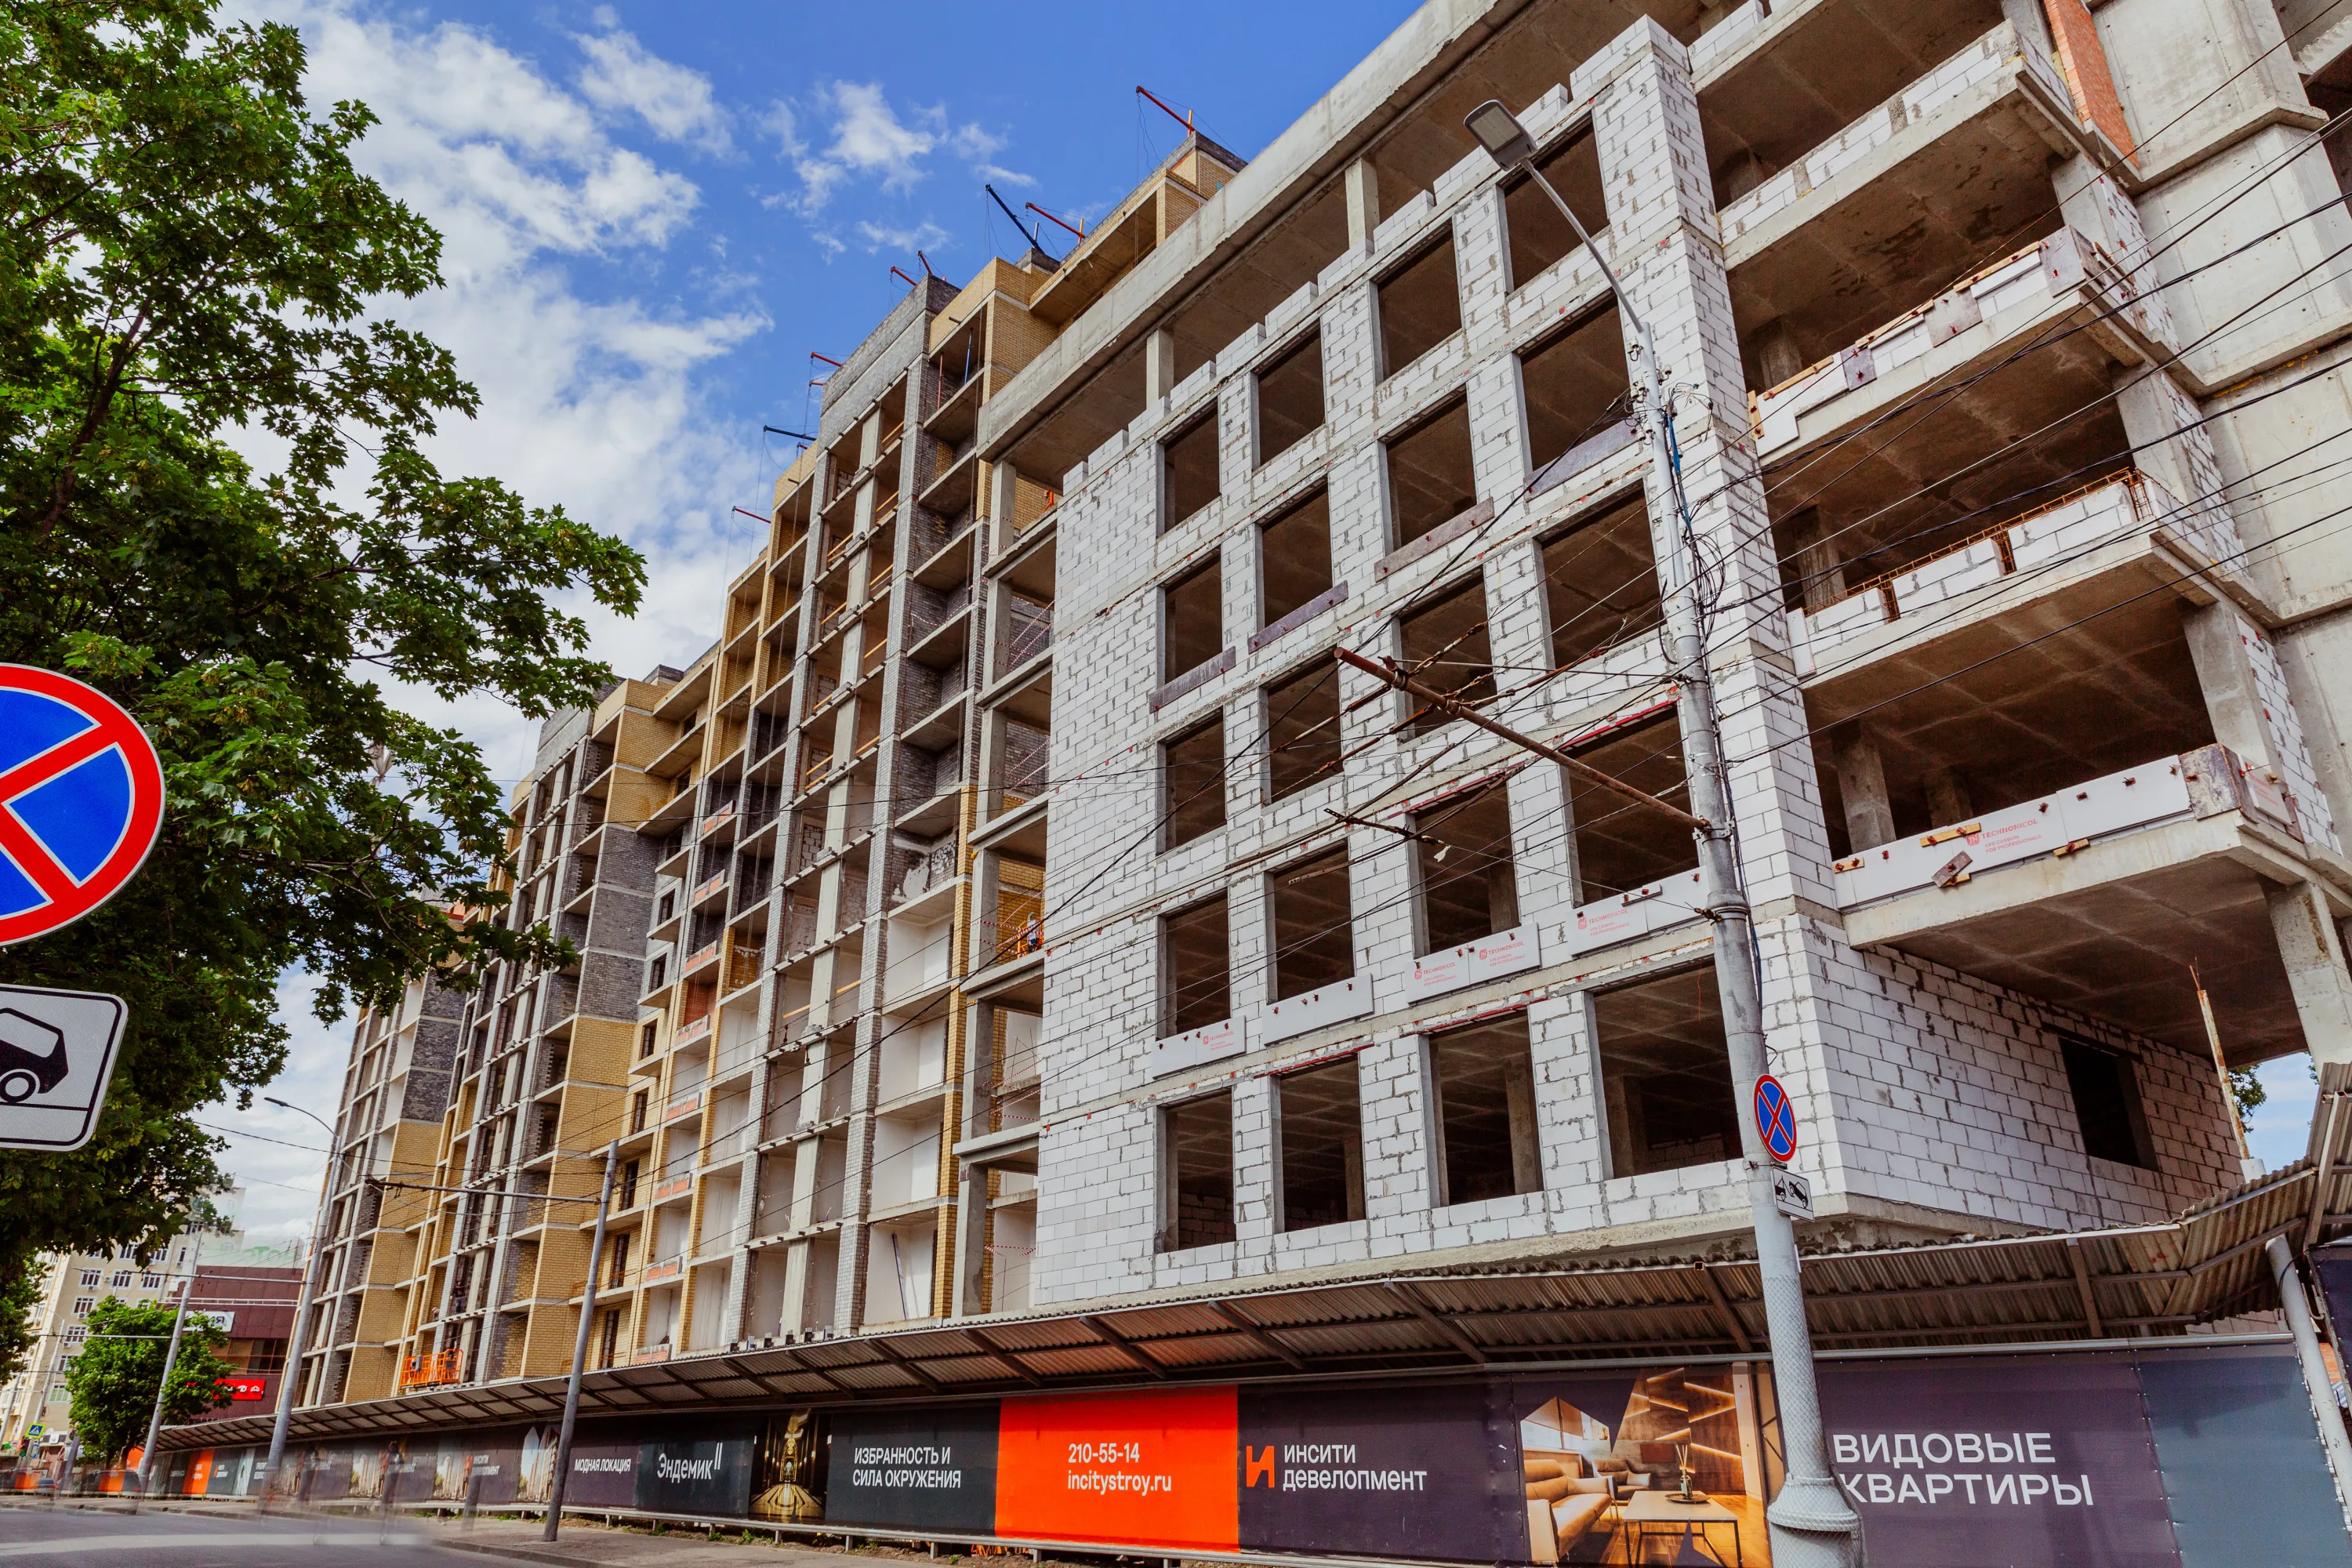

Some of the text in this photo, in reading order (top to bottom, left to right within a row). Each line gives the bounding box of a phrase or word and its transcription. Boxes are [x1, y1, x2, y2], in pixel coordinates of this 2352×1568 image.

[1982, 818, 2038, 839] TECHNONICOL
[1996, 835, 2020, 845] CARBON
[1998, 834, 2042, 850] PROFESSIONALS
[1588, 908, 1628, 924] TECHNONICOL
[1489, 942, 1524, 955] TECHNONICOL
[1423, 961, 1456, 975] TECHNONICOL
[854, 1446, 951, 1465] ИЗБРАННОСТЬ И
[1068, 1443, 1140, 1463] 210-55-14
[1833, 1432, 2056, 1468] ВИДОВЫЕ
[574, 1458, 632, 1474] МОДНАЯ ЛОКАЦИЯ
[657, 1453, 713, 1483] Эндемик
[852, 1469, 961, 1488] СИЛА ОКРУЖЕНИЯ
[1068, 1469, 1172, 1497] incitystroy.ru
[1838, 1473, 2094, 1506] КВАРТИРЫ
